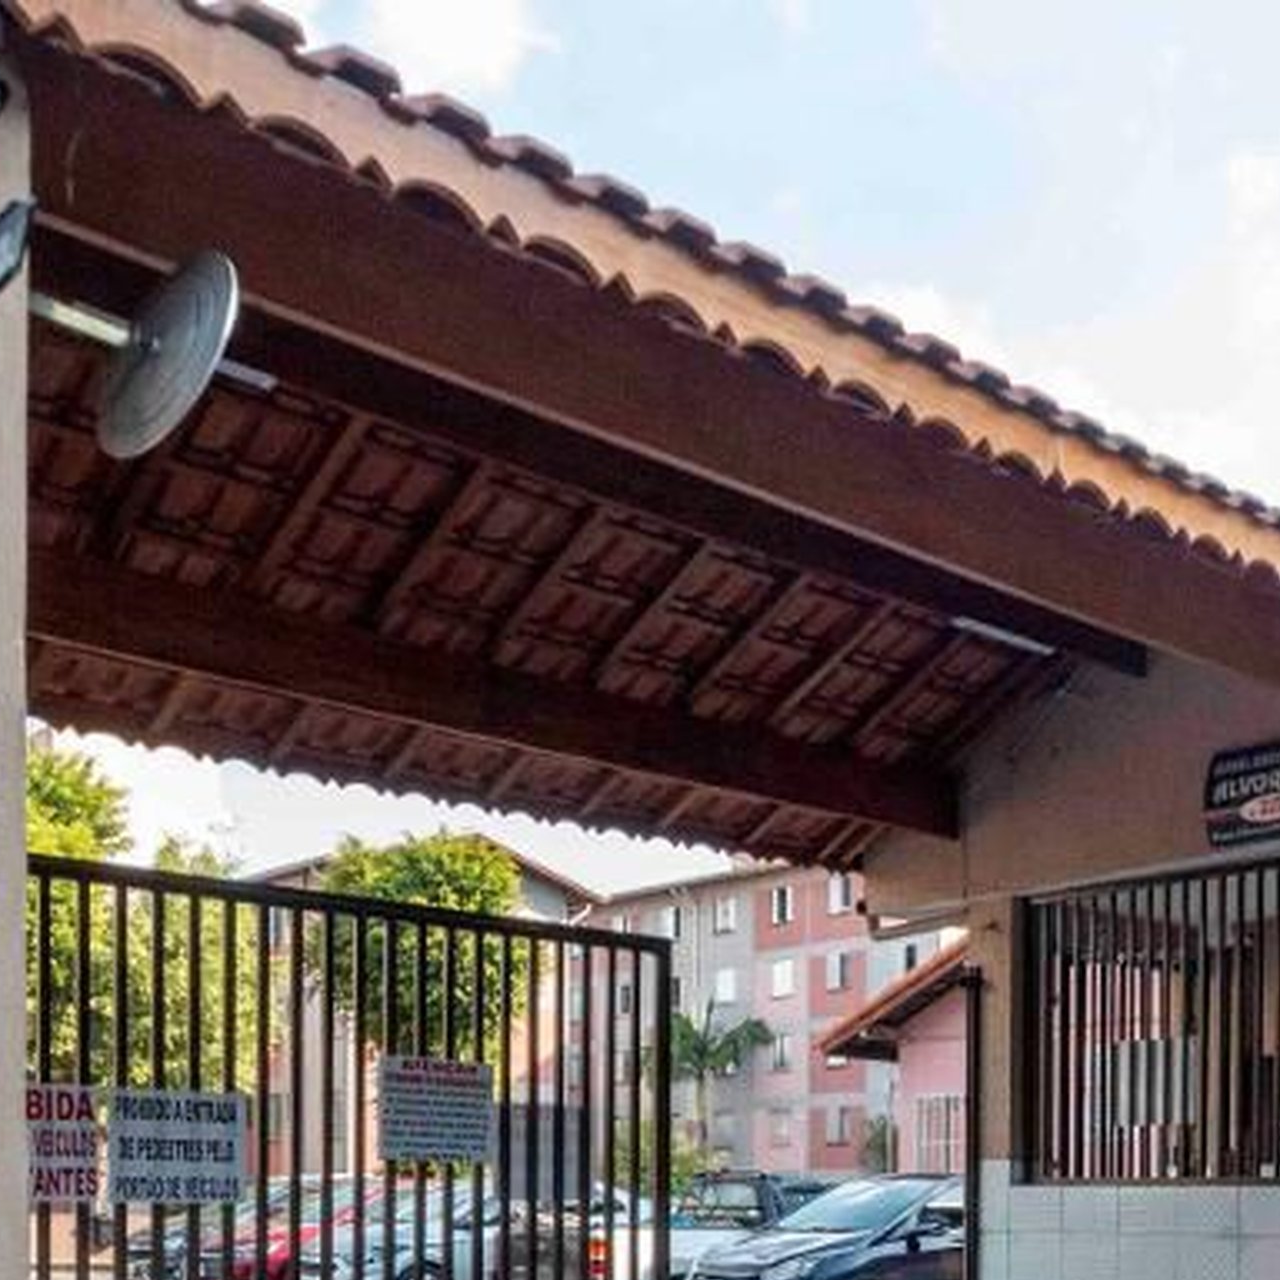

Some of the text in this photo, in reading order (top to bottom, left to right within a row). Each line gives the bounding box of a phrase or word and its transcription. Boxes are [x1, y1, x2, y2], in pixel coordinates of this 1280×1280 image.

[173, 1100, 183, 1122] A
[185, 1099, 237, 1124] ENTRADA
[118, 1135, 235, 1163] DE PEDESTRES PELO
